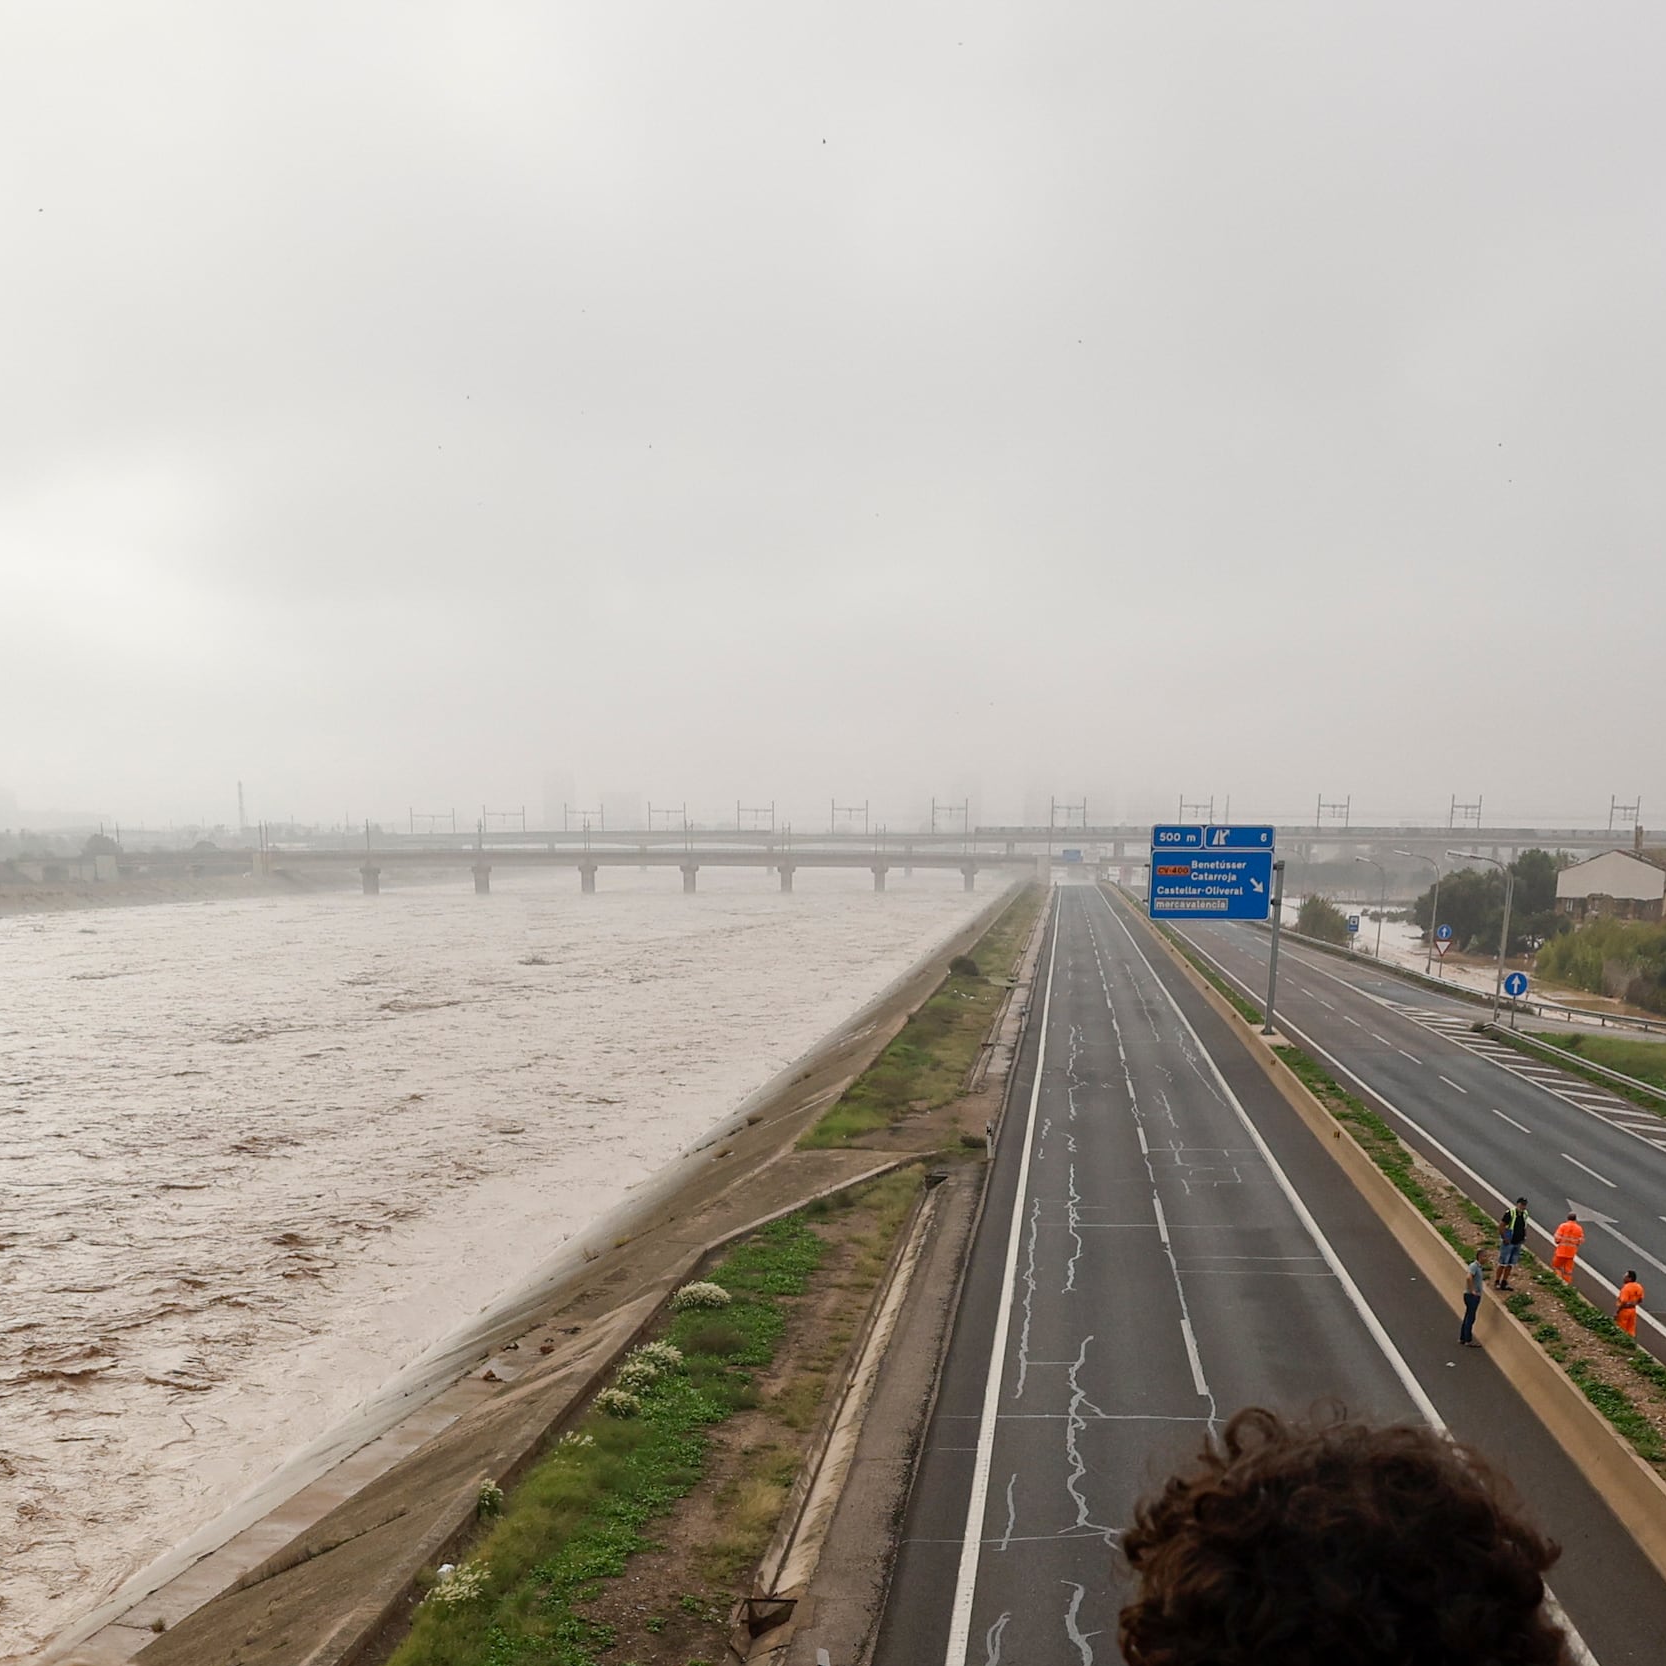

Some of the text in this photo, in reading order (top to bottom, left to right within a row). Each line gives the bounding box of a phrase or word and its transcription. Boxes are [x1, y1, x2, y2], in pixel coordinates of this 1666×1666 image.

[1159, 832, 1196, 842] 500 m
[1260, 832, 1268, 842] 6
[1191, 860, 1247, 870] Benetússer
[1190, 872, 1237, 883] Catarroja
[1157, 886, 1244, 896] Castellar-Oliveral
[1156, 899, 1226, 910] mercavalencia
